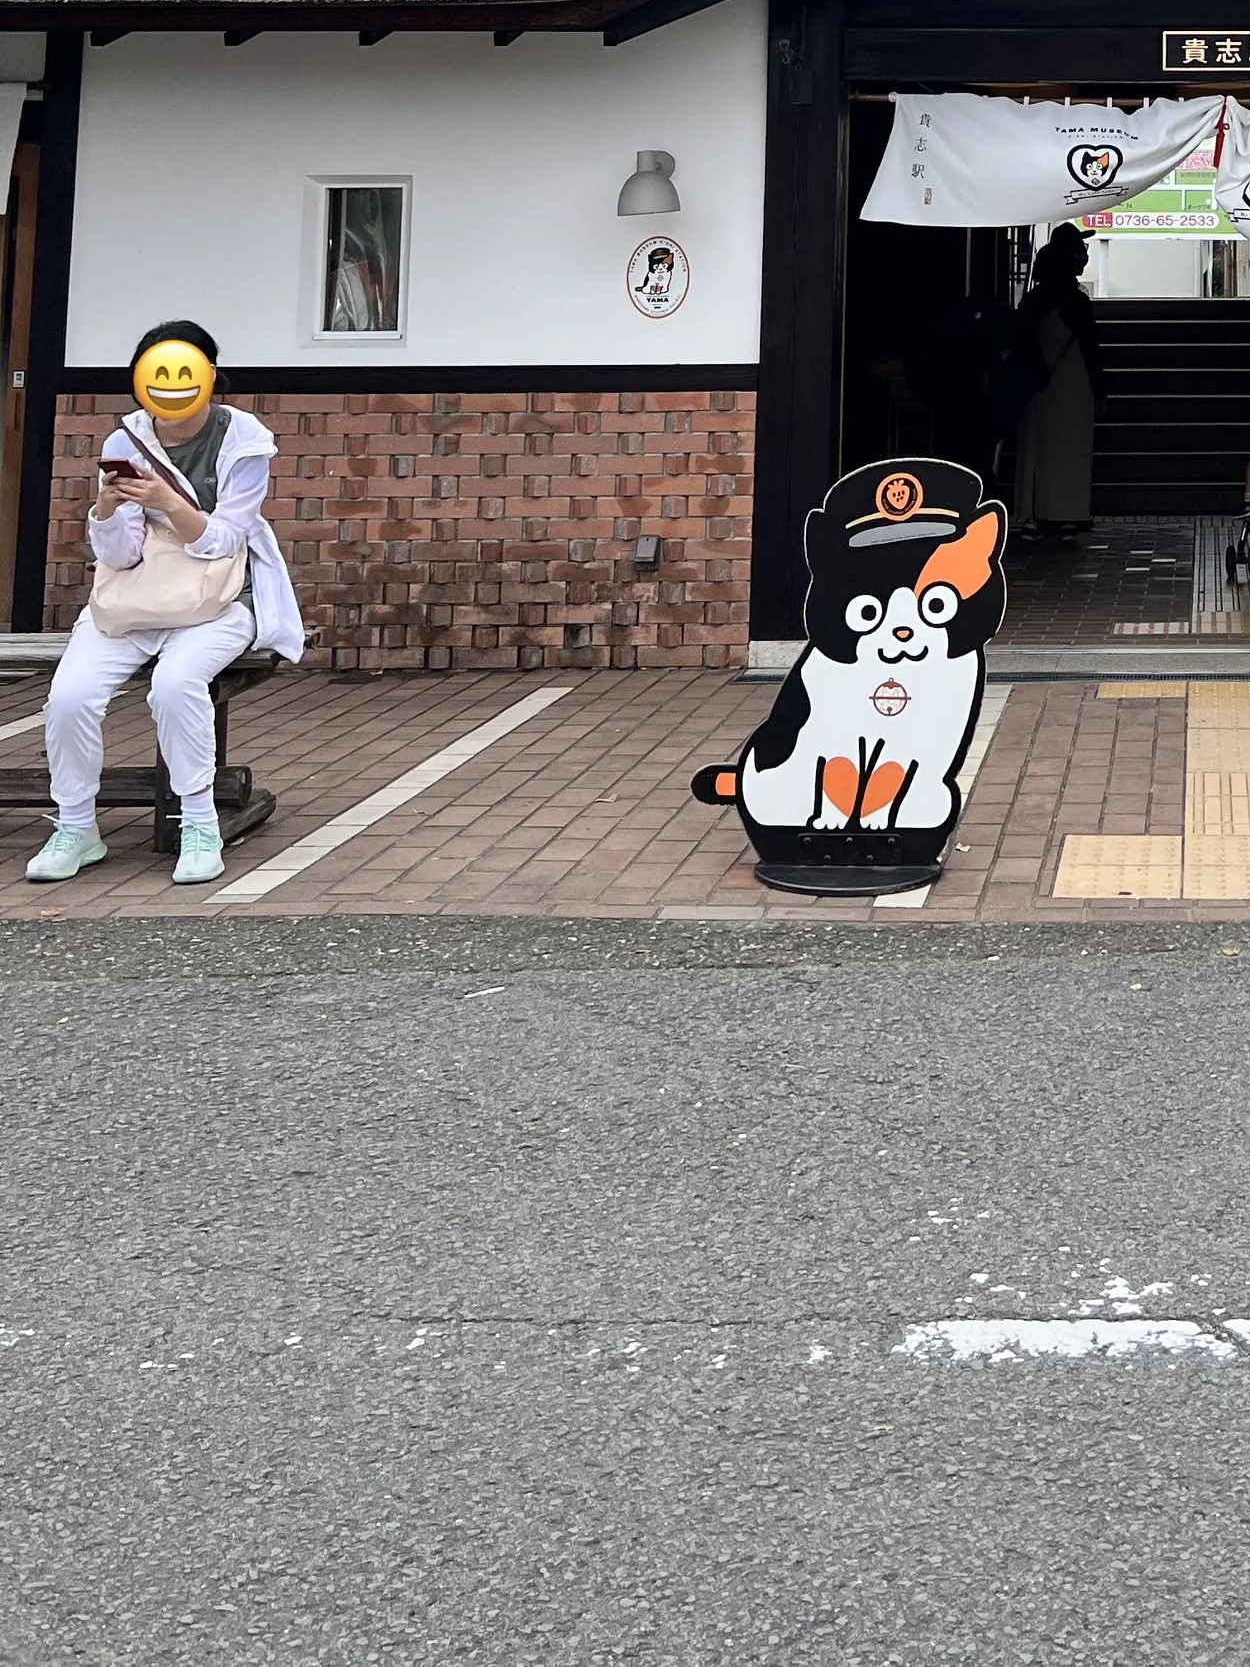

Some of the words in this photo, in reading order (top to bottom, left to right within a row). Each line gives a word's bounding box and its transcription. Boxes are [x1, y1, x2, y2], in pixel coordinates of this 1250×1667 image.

[1090, 127, 1139, 140] MUSEUM
[911, 113, 932, 179] 貴志駅
[1087, 215, 1112, 227] TEL
[1115, 215, 1215, 227] 0736-65-2533
